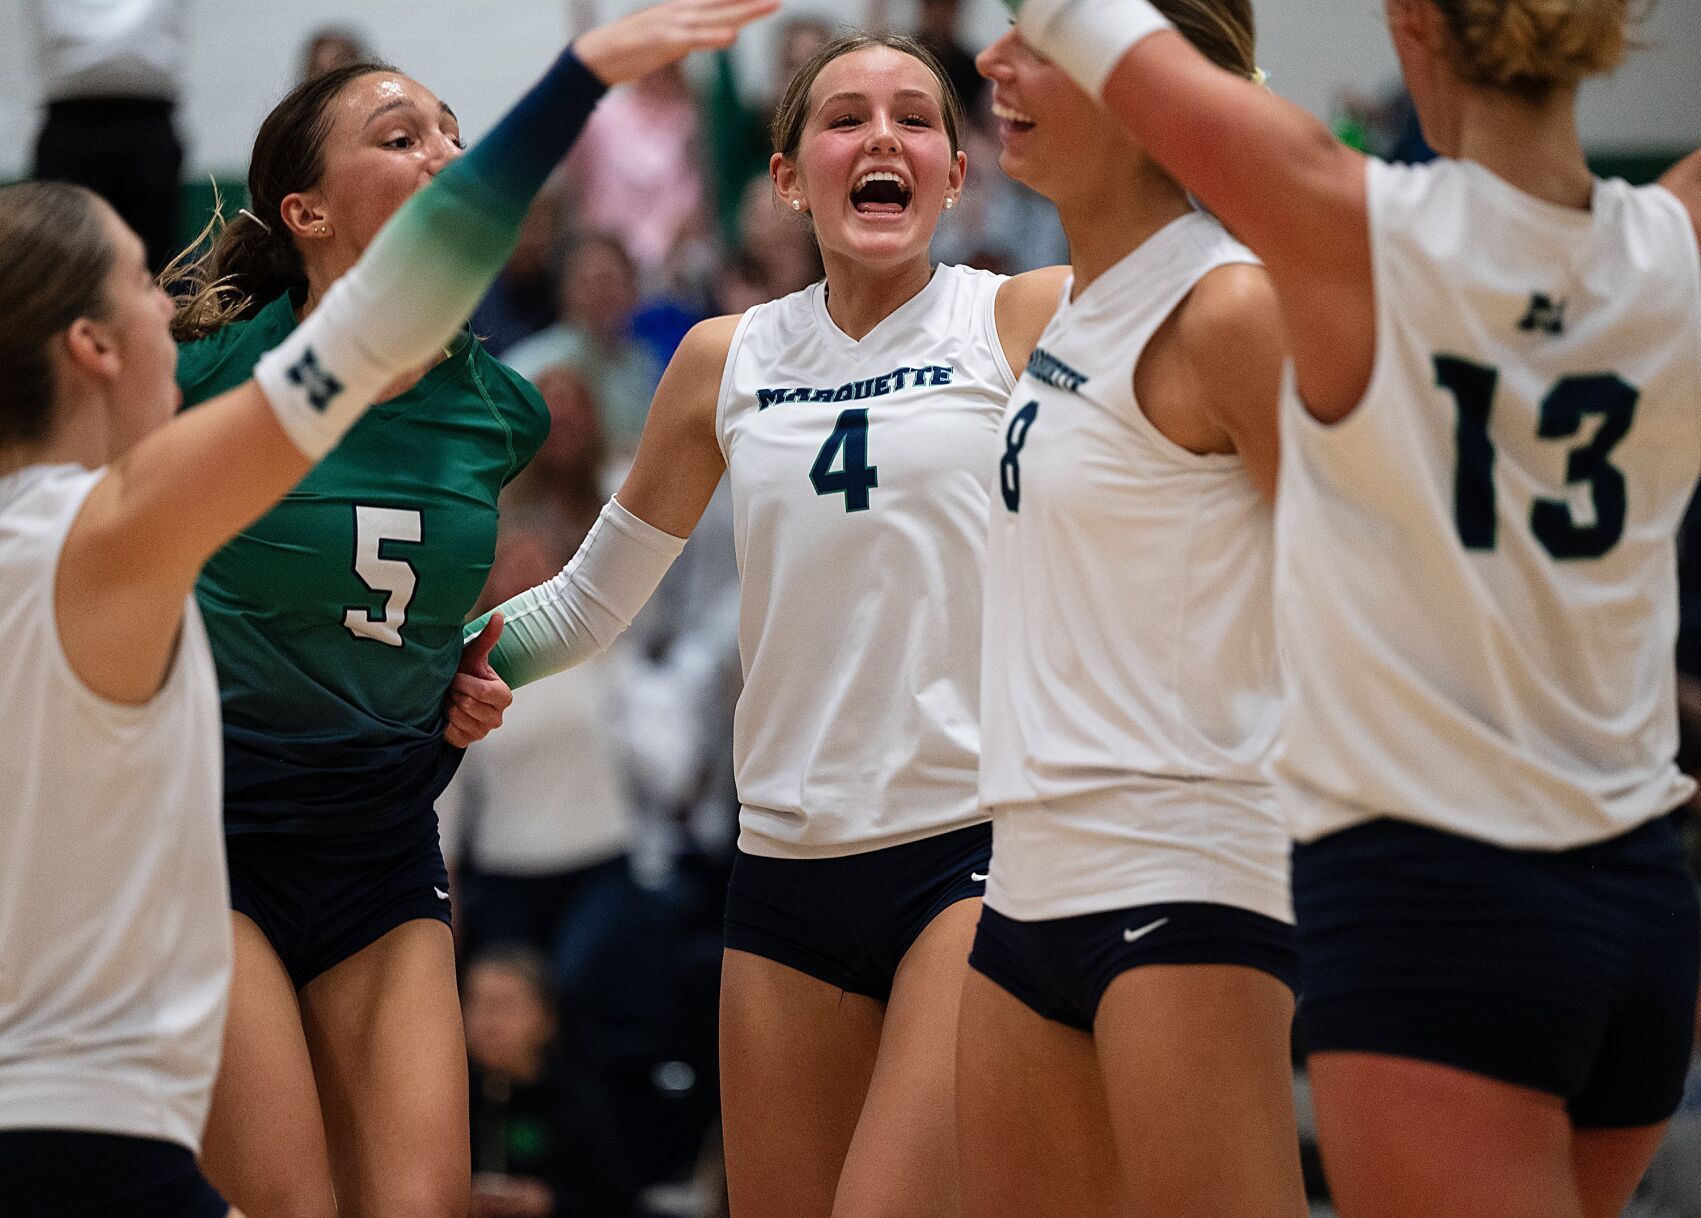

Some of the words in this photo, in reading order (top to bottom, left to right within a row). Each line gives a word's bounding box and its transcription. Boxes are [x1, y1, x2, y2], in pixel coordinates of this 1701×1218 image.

[809, 407, 878, 513] 4
[1000, 399, 1040, 514] 8
[1431, 351, 1641, 560] 13
[342, 503, 423, 648] 5
